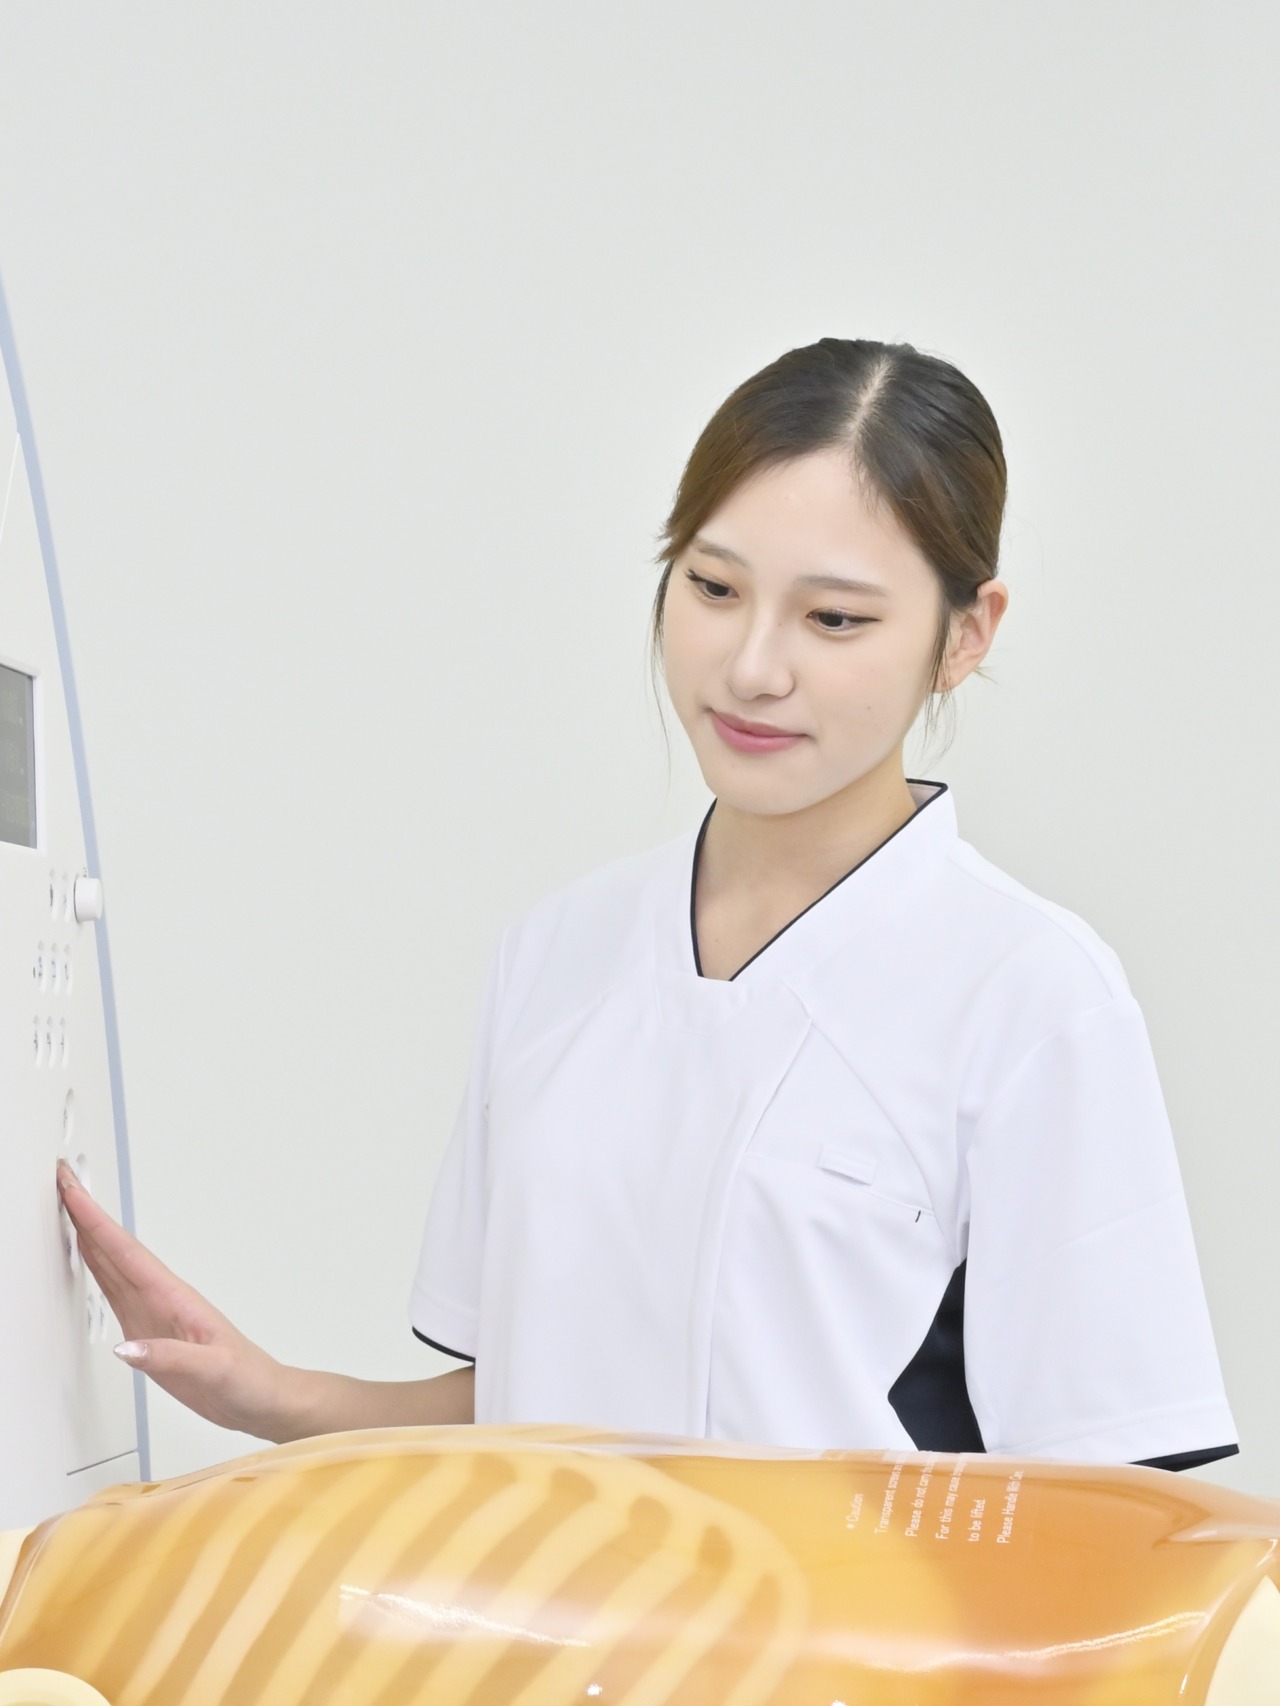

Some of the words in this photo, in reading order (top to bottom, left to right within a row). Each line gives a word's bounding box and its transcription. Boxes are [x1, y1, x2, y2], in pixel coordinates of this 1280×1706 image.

[915, 1487, 927, 1498] not
[945, 1492, 958, 1507] may
[846, 1493, 864, 1522] Caution
[911, 1498, 924, 1508] do
[874, 1489, 896, 1535] Transparent
[938, 1508, 953, 1523] this
[904, 1509, 922, 1537] Please
[968, 1520, 982, 1531] be
[996, 1516, 1014, 1544] Please
[935, 1524, 950, 1540] For
[967, 1532, 980, 1542] to
